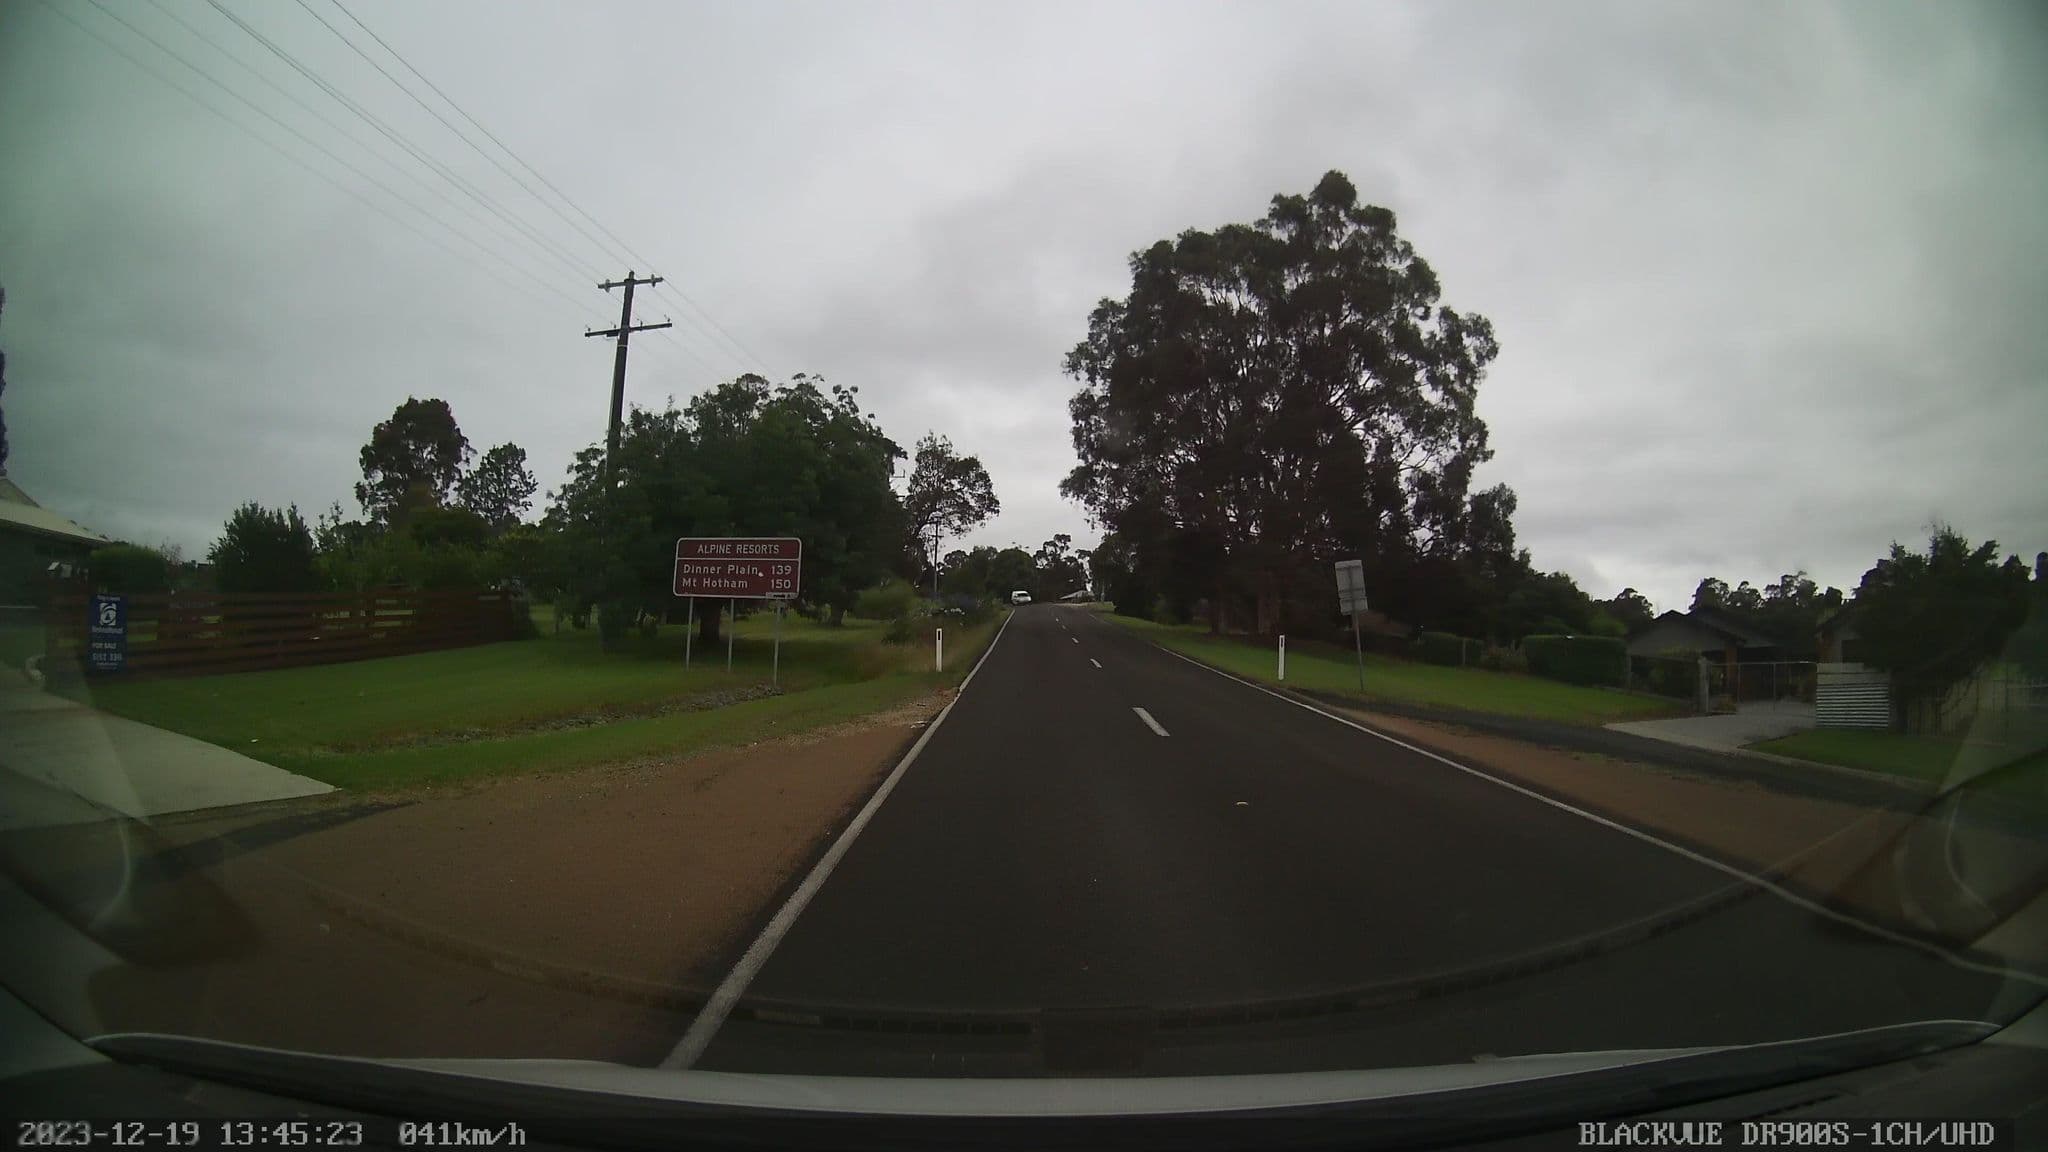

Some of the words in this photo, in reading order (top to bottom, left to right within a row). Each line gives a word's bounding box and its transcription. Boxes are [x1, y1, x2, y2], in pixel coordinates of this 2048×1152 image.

[697, 544, 731, 554] ALPINE
[736, 544, 780, 554] RESORTS
[683, 564, 721, 574] Dinner
[727, 564, 758, 574] Plain
[770, 565, 792, 575] 139
[682, 578, 697, 587] Mt
[703, 578, 748, 588] Hotham
[770, 579, 791, 589] 150
